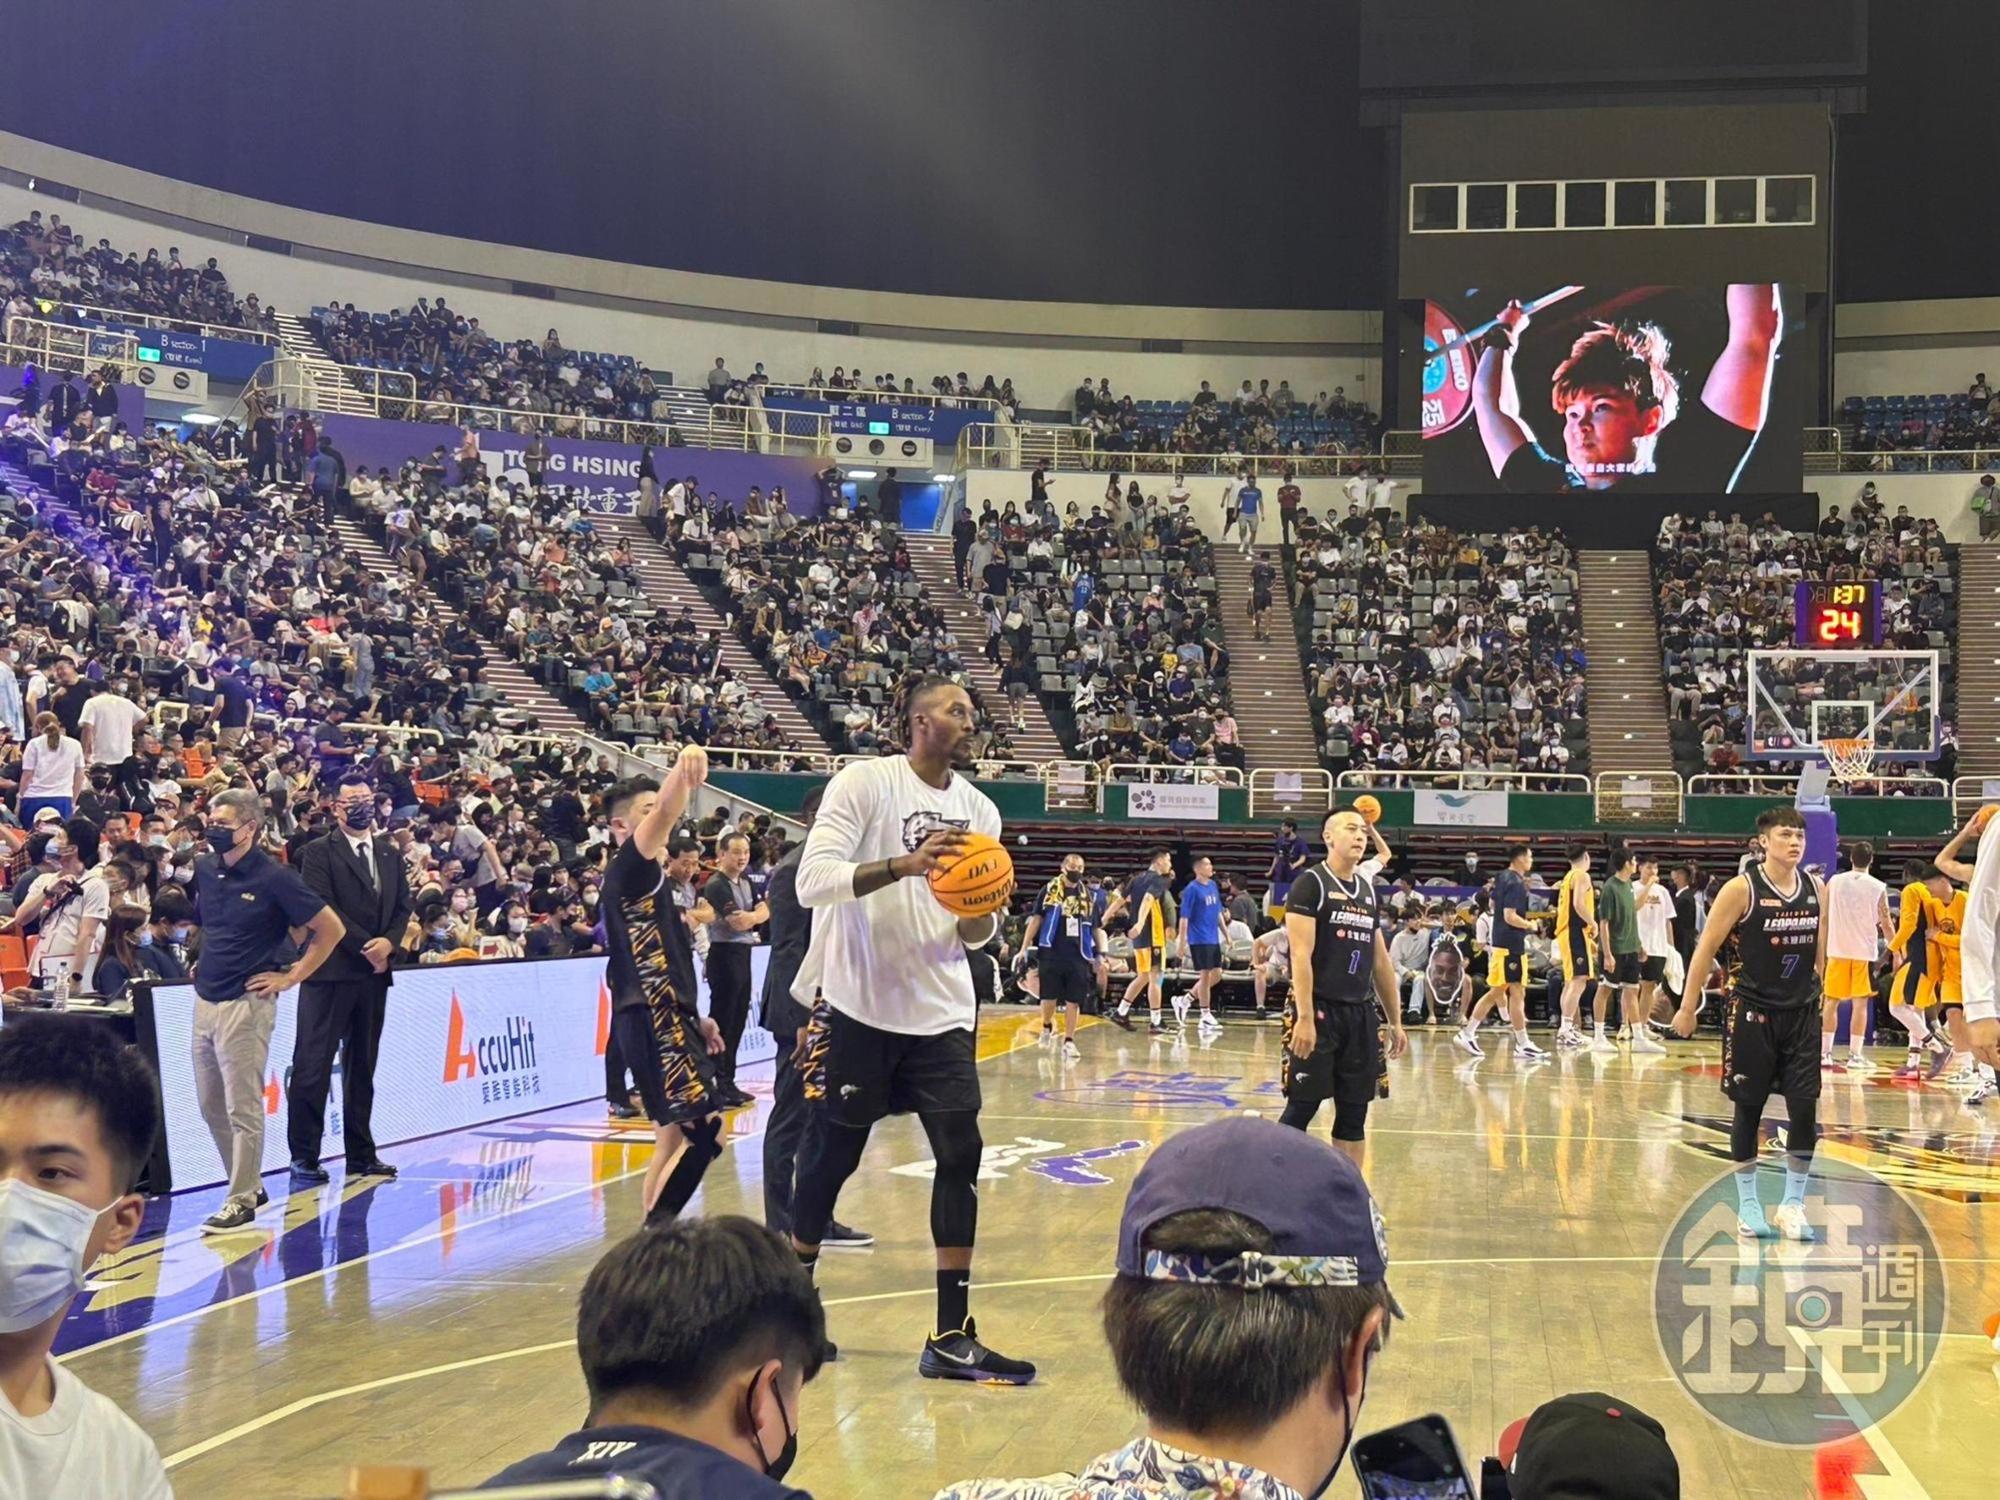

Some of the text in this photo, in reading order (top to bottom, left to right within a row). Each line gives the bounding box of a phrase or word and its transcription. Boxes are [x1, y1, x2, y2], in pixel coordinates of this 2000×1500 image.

[160, 334, 169, 347] B
[201, 339, 206, 352] 1
[891, 408, 899, 419] B
[928, 410, 935, 422] 2
[504, 450, 641, 478] TOG HSING
[1820, 609, 1862, 641] 24
[1347, 949, 1360, 975] 1
[1779, 954, 1800, 979] 7
[443, 986, 537, 1083] AccuHit
